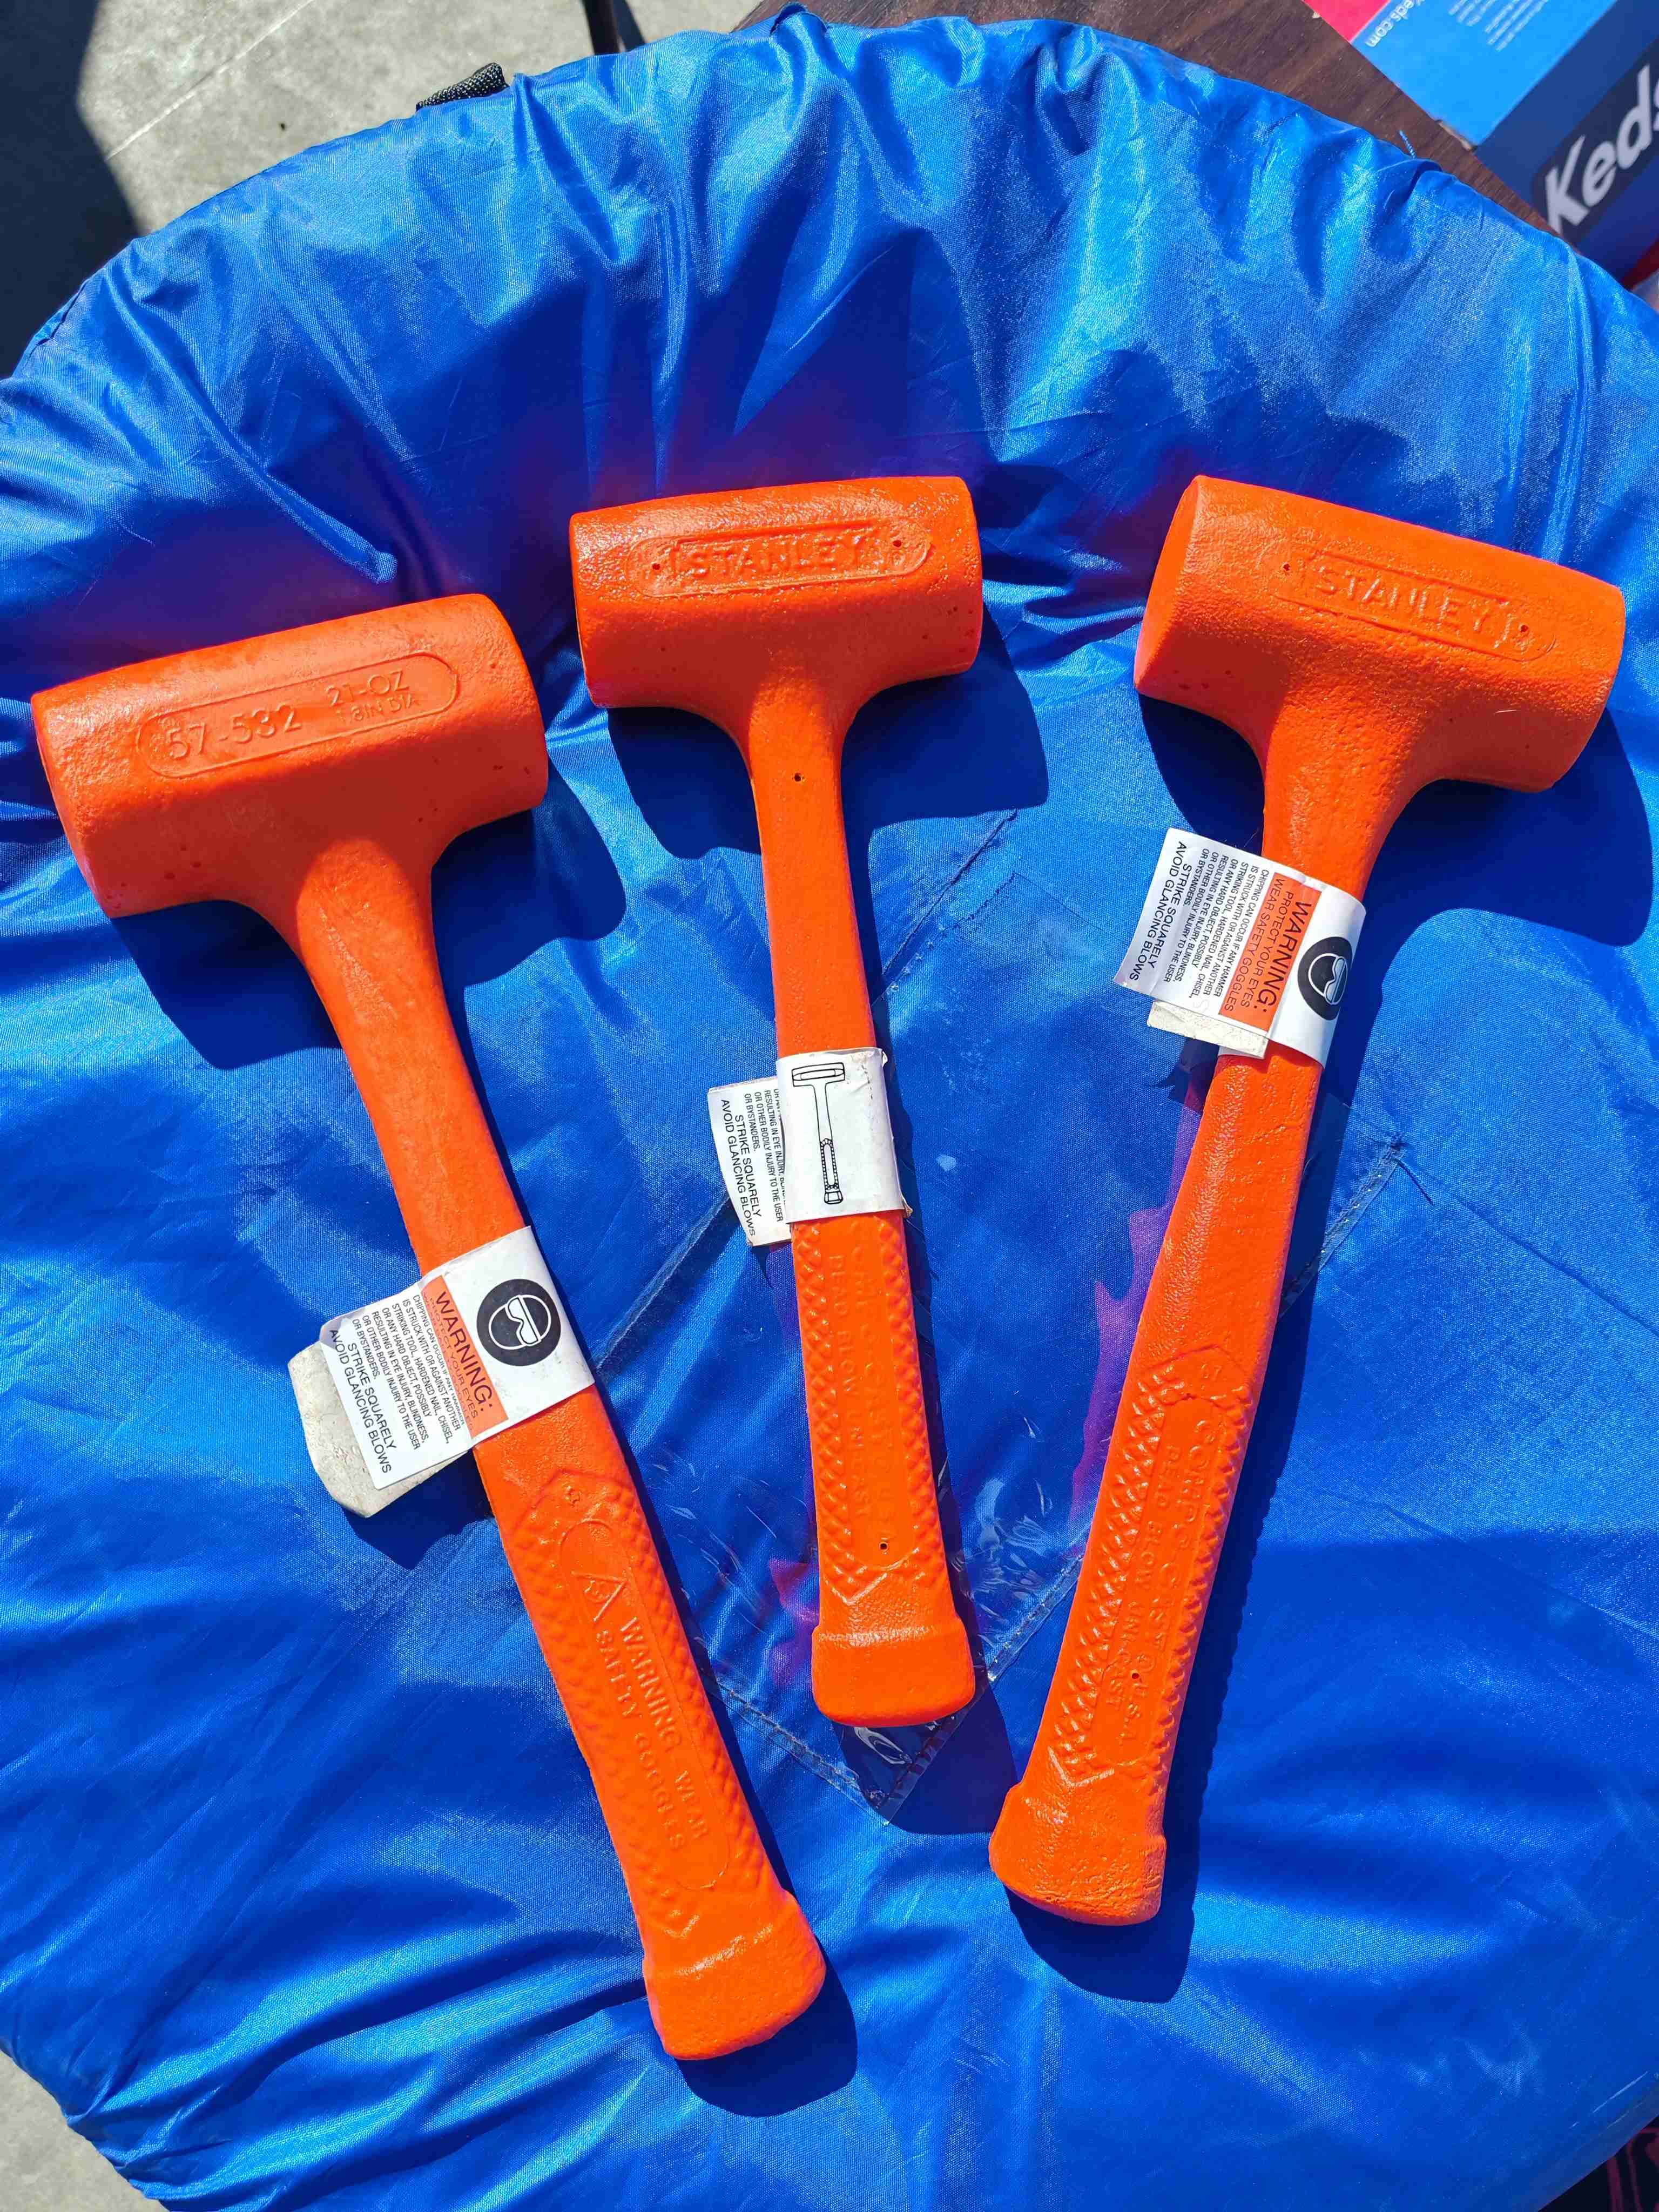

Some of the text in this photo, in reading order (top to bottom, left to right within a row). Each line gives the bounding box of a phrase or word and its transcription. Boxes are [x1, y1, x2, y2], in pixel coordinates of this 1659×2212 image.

[1545, 64, 1659, 233] Ked
[687, 534, 868, 578] STANLEY
[1316, 565, 1491, 632] STANLEY
[165, 703, 303, 761] 57-532
[326, 669, 409, 706] 21-OZ
[1129, 841, 1186, 980] AVOID GLANCING BLOWS
[1147, 864, 1192, 968] STRIKE SQUARELY
[1163, 852, 1219, 982] OR OTHER BODILY INJURY TO THE USER
[1172, 854, 1229, 981] RESULTING IN EYE INJURY, BLINDNESS,
[1183, 848, 1210, 906] OR BYSTANDERS.
[1191, 859, 1238, 968] OR ANY HARD OBJECT, POSSIBLY
[1244, 902, 1256, 917] CAN
[1251, 869, 1269, 901] CHIPPING
[1188, 861, 1249, 998] STRIKING TOOL, HARDENED NAIL, CHISEL,
[1203, 865, 1259, 995] IS STRUCK WITH OR AGAINST ANOTHER
[1224, 878, 1285, 1011] WEAR SAFETY GOGGLES
[1226, 949, 1237, 965] ANY
[1235, 918, 1250, 942] OCCUR
[1240, 891, 1294, 1007] PROTECT YOUR EYES
[1253, 901, 1312, 1012] WARNING:
[1213, 965, 1231, 997] HAMMER
[744, 1093, 760, 1151] OR BYSTANDERS.
[754, 1091, 762, 1102] OR
[756, 1103, 766, 1126] OTHER
[760, 1127, 771, 1150] BODILY
[764, 1090, 777, 1126] RESULTING
[772, 1136, 781, 1149] EYE
[721, 1100, 755, 1236] AVOID GLANCING BLOWS
[734, 1115, 761, 1216] STRIKE SQUARELY
[765, 1152, 775, 1176] INJURY
[769, 1177, 778, 1187] TO
[771, 1188, 780, 1202] THE
[774, 1150, 784, 1176] INJURY,
[774, 1203, 783, 1222] USER
[347, 1343, 396, 1448] STRIKE SQUARELY
[352, 1319, 380, 1379] OR BYSTANDERS.
[362, 1315, 420, 1449] OR OTHER BODILY INJURY TO THE USER
[372, 1311, 429, 1443] RESULTING IN EYE INJURY, BLINDNESS,
[382, 1307, 432, 1417] OR ANY HARD OBJECT, POSSIBLY
[392, 1303, 452, 1444] STRIKING TOOL, HARDENED NAIL, CHISEL,
[402, 1298, 461, 1431] IS STRUCK WITH OR AGAINST ANOTHER
[429, 1298, 478, 1419] PROTECT YOUR EYES
[436, 1291, 492, 1411] WARNING:
[329, 1330, 392, 1473] AVOID GLANCING BLOWS
[595, 1629, 642, 1719] SAFETY
[621, 1616, 684, 1750] WARNING
